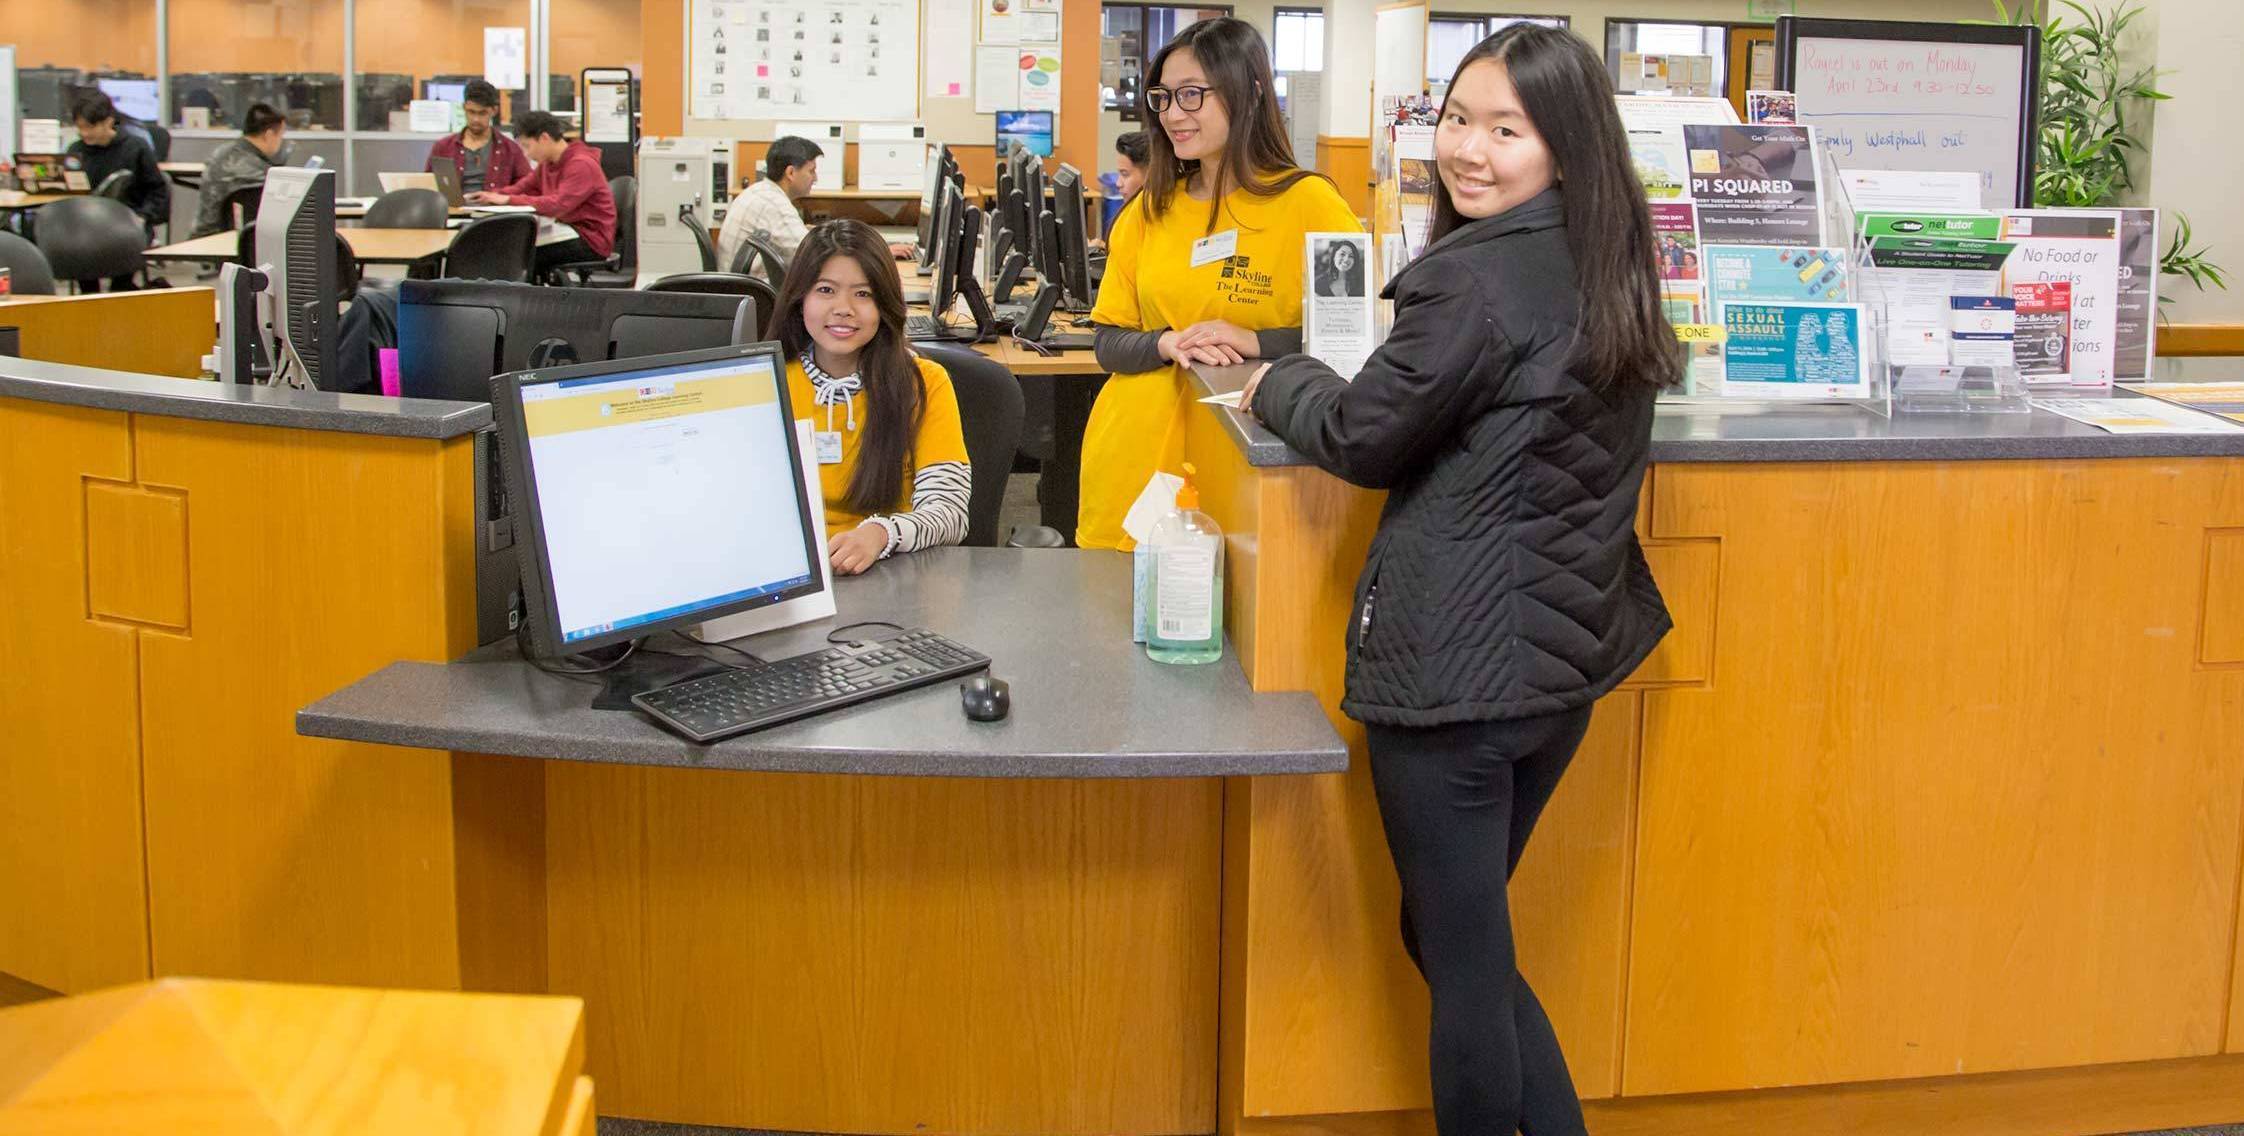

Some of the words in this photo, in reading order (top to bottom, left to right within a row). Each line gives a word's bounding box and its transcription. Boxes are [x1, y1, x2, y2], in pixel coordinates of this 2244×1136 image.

[1851, 58, 1861, 71] is
[1869, 56, 1889, 71] out
[1897, 58, 1914, 72] on
[1926, 47, 1976, 86] Monday
[1827, 74, 1856, 95] April
[1866, 76, 1899, 94] 23rd
[1941, 130, 1967, 148] out
[1692, 178, 1709, 193] PI
[1713, 179, 1795, 196] SQUARED
[1929, 219, 1975, 230] nettutor
[2022, 248, 2043, 263] No
[2046, 248, 2081, 263] Food
[2083, 251, 2098, 263] or
[1877, 257, 1896, 265] Live
[1898, 258, 1954, 267] One-on-One
[1954, 260, 1993, 270] Tutoring
[1235, 268, 1273, 284] Skyline
[2038, 271, 2081, 284] Drinks
[1216, 281, 1233, 292] The
[1234, 283, 1274, 297] Learning
[2014, 286, 2034, 294] YOUR
[1228, 293, 1259, 305] Center
[2081, 296, 2095, 308] at
[1727, 313, 1785, 324] SEXUAL
[1685, 327, 1710, 338] ONE
[1727, 324, 1785, 335] ASSAULT
[518, 373, 537, 382] NEC
